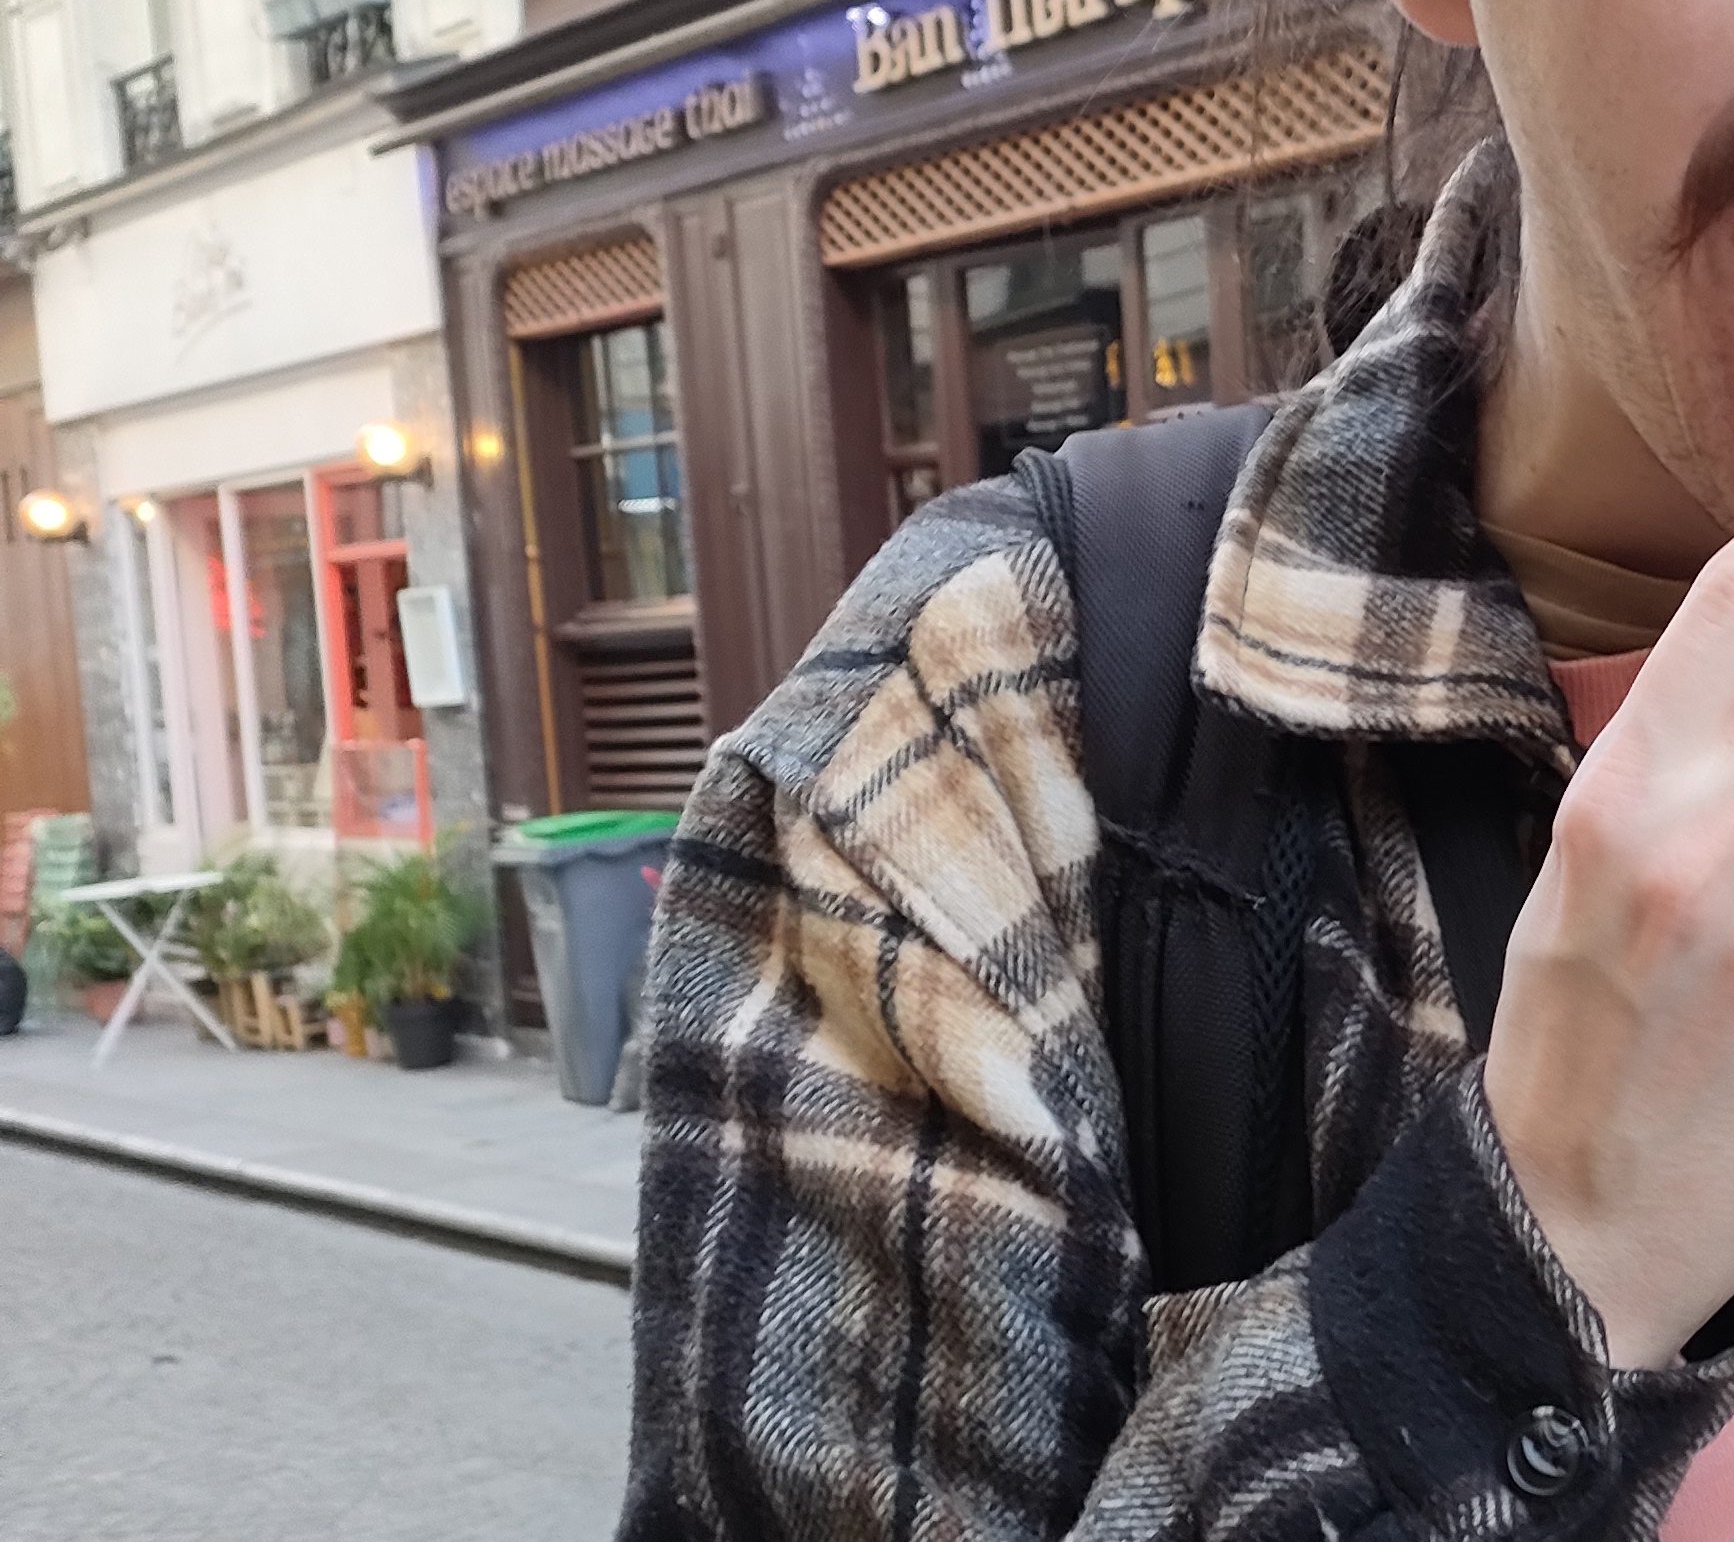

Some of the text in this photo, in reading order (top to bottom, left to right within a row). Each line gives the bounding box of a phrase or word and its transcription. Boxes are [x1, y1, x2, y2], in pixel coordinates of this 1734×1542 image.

[847, 2, 965, 94] Ban
[446, 149, 540, 224] espace
[542, 106, 676, 184] massage
